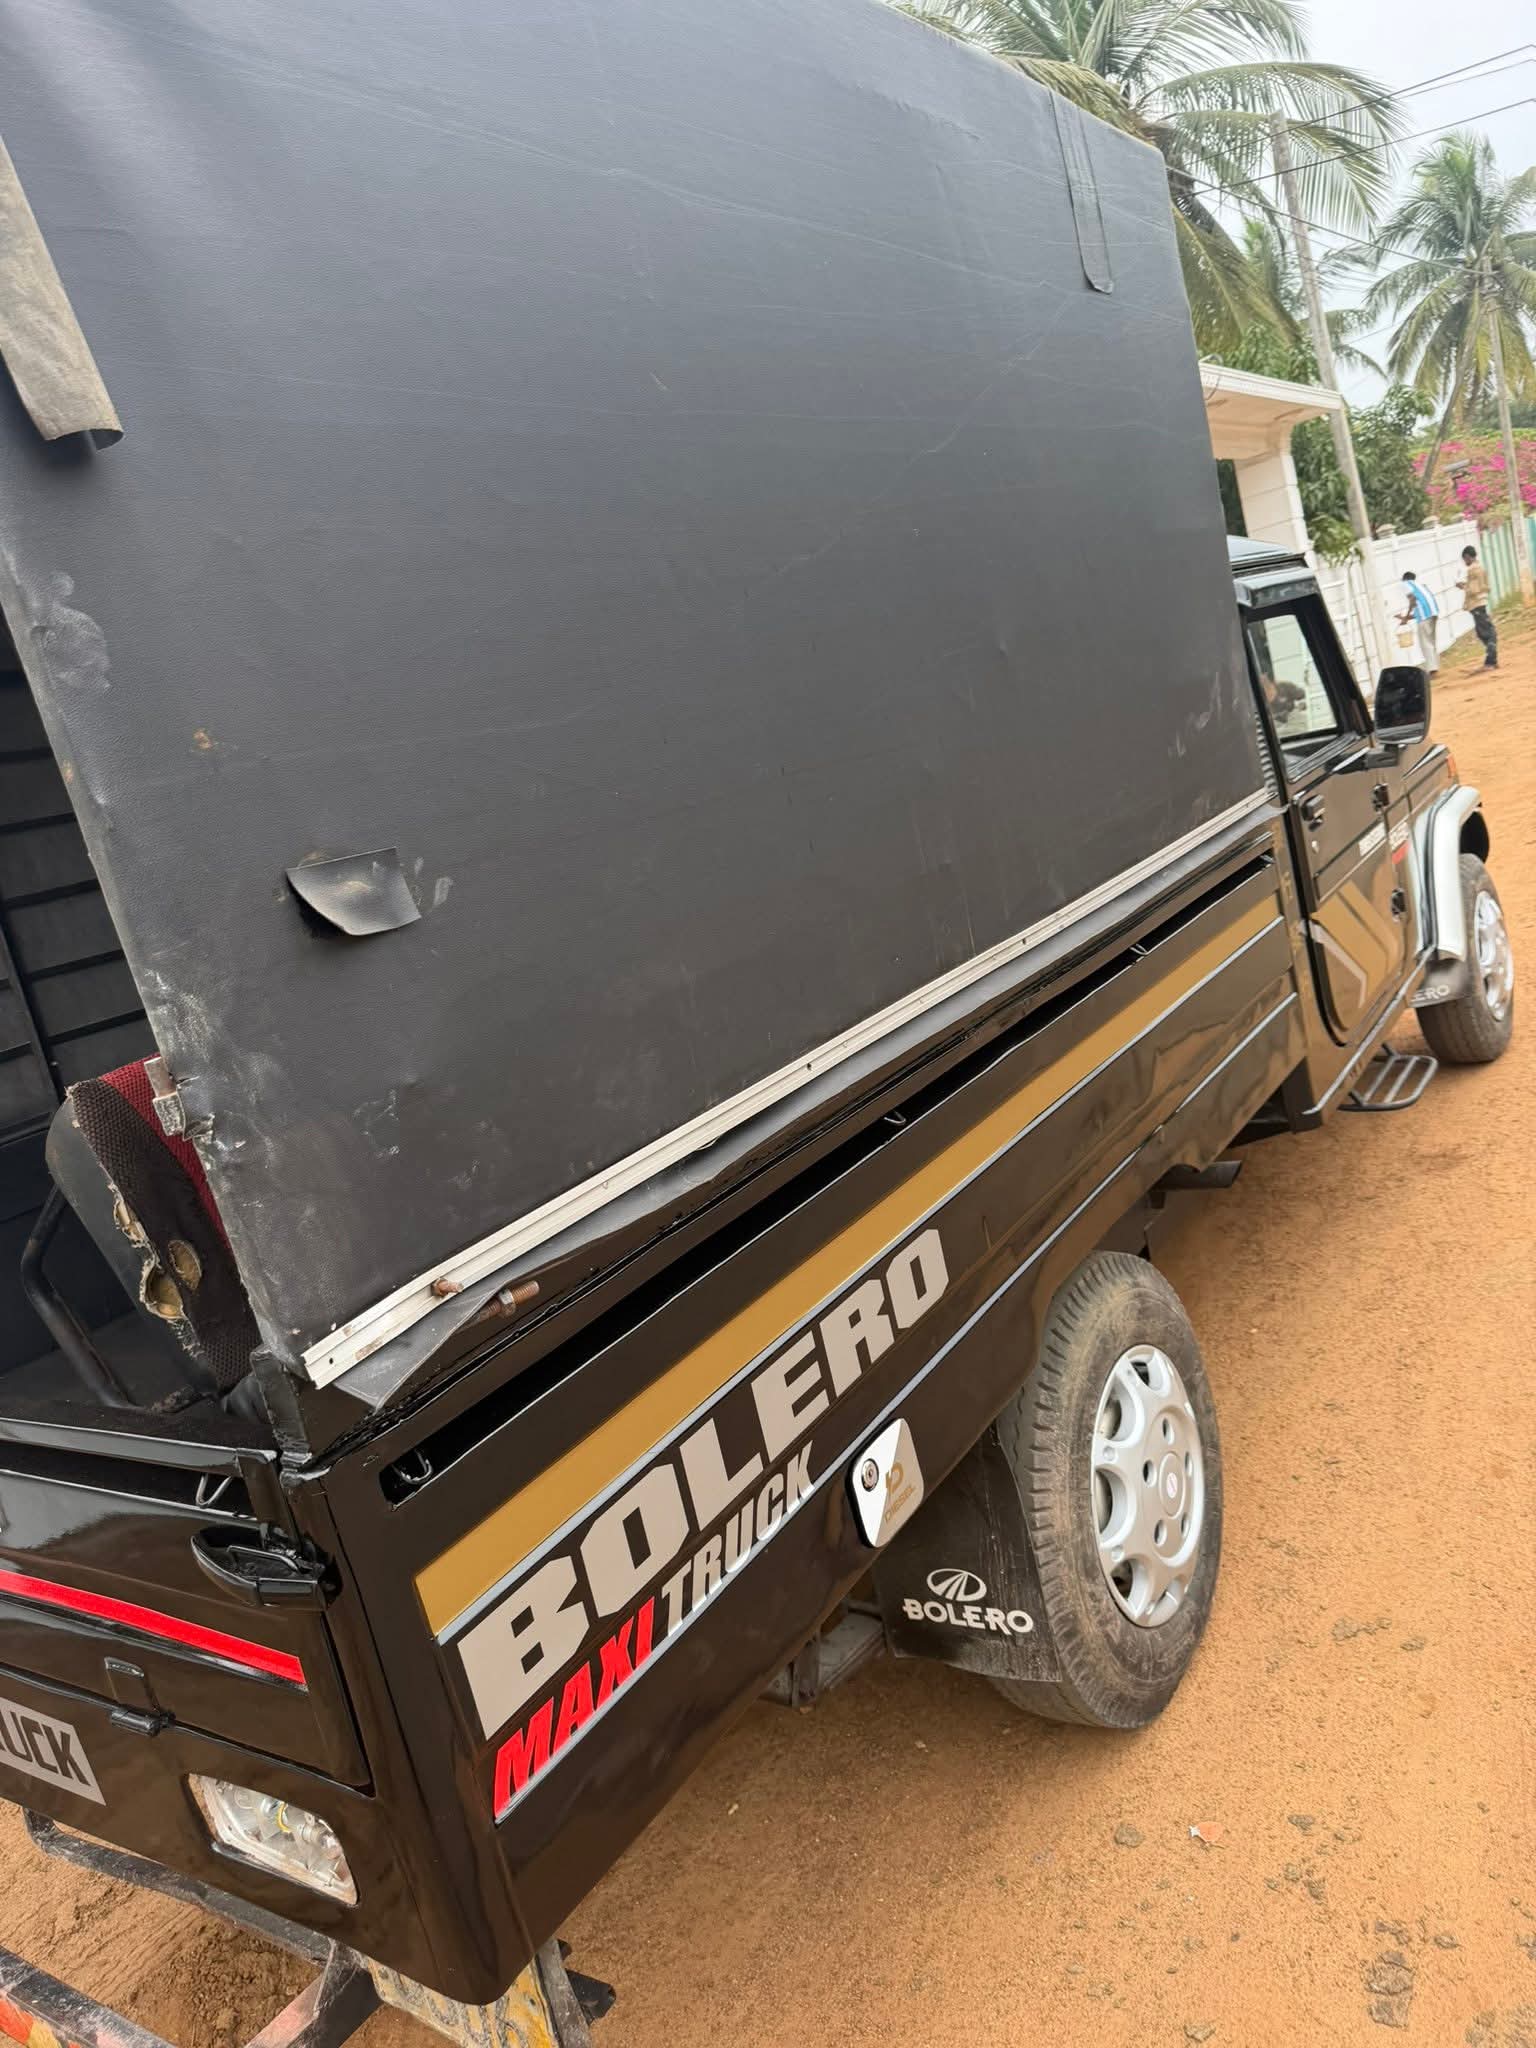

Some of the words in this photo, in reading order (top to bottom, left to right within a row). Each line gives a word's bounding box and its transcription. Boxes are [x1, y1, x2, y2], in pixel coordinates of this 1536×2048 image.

[457, 1228, 950, 1741] BOLERO
[494, 1595, 656, 1822] MAXI
[660, 1440, 815, 1638] TRUCK
[902, 1598, 1034, 1636] BOLERO
[0, 1708, 92, 1788] UCK
